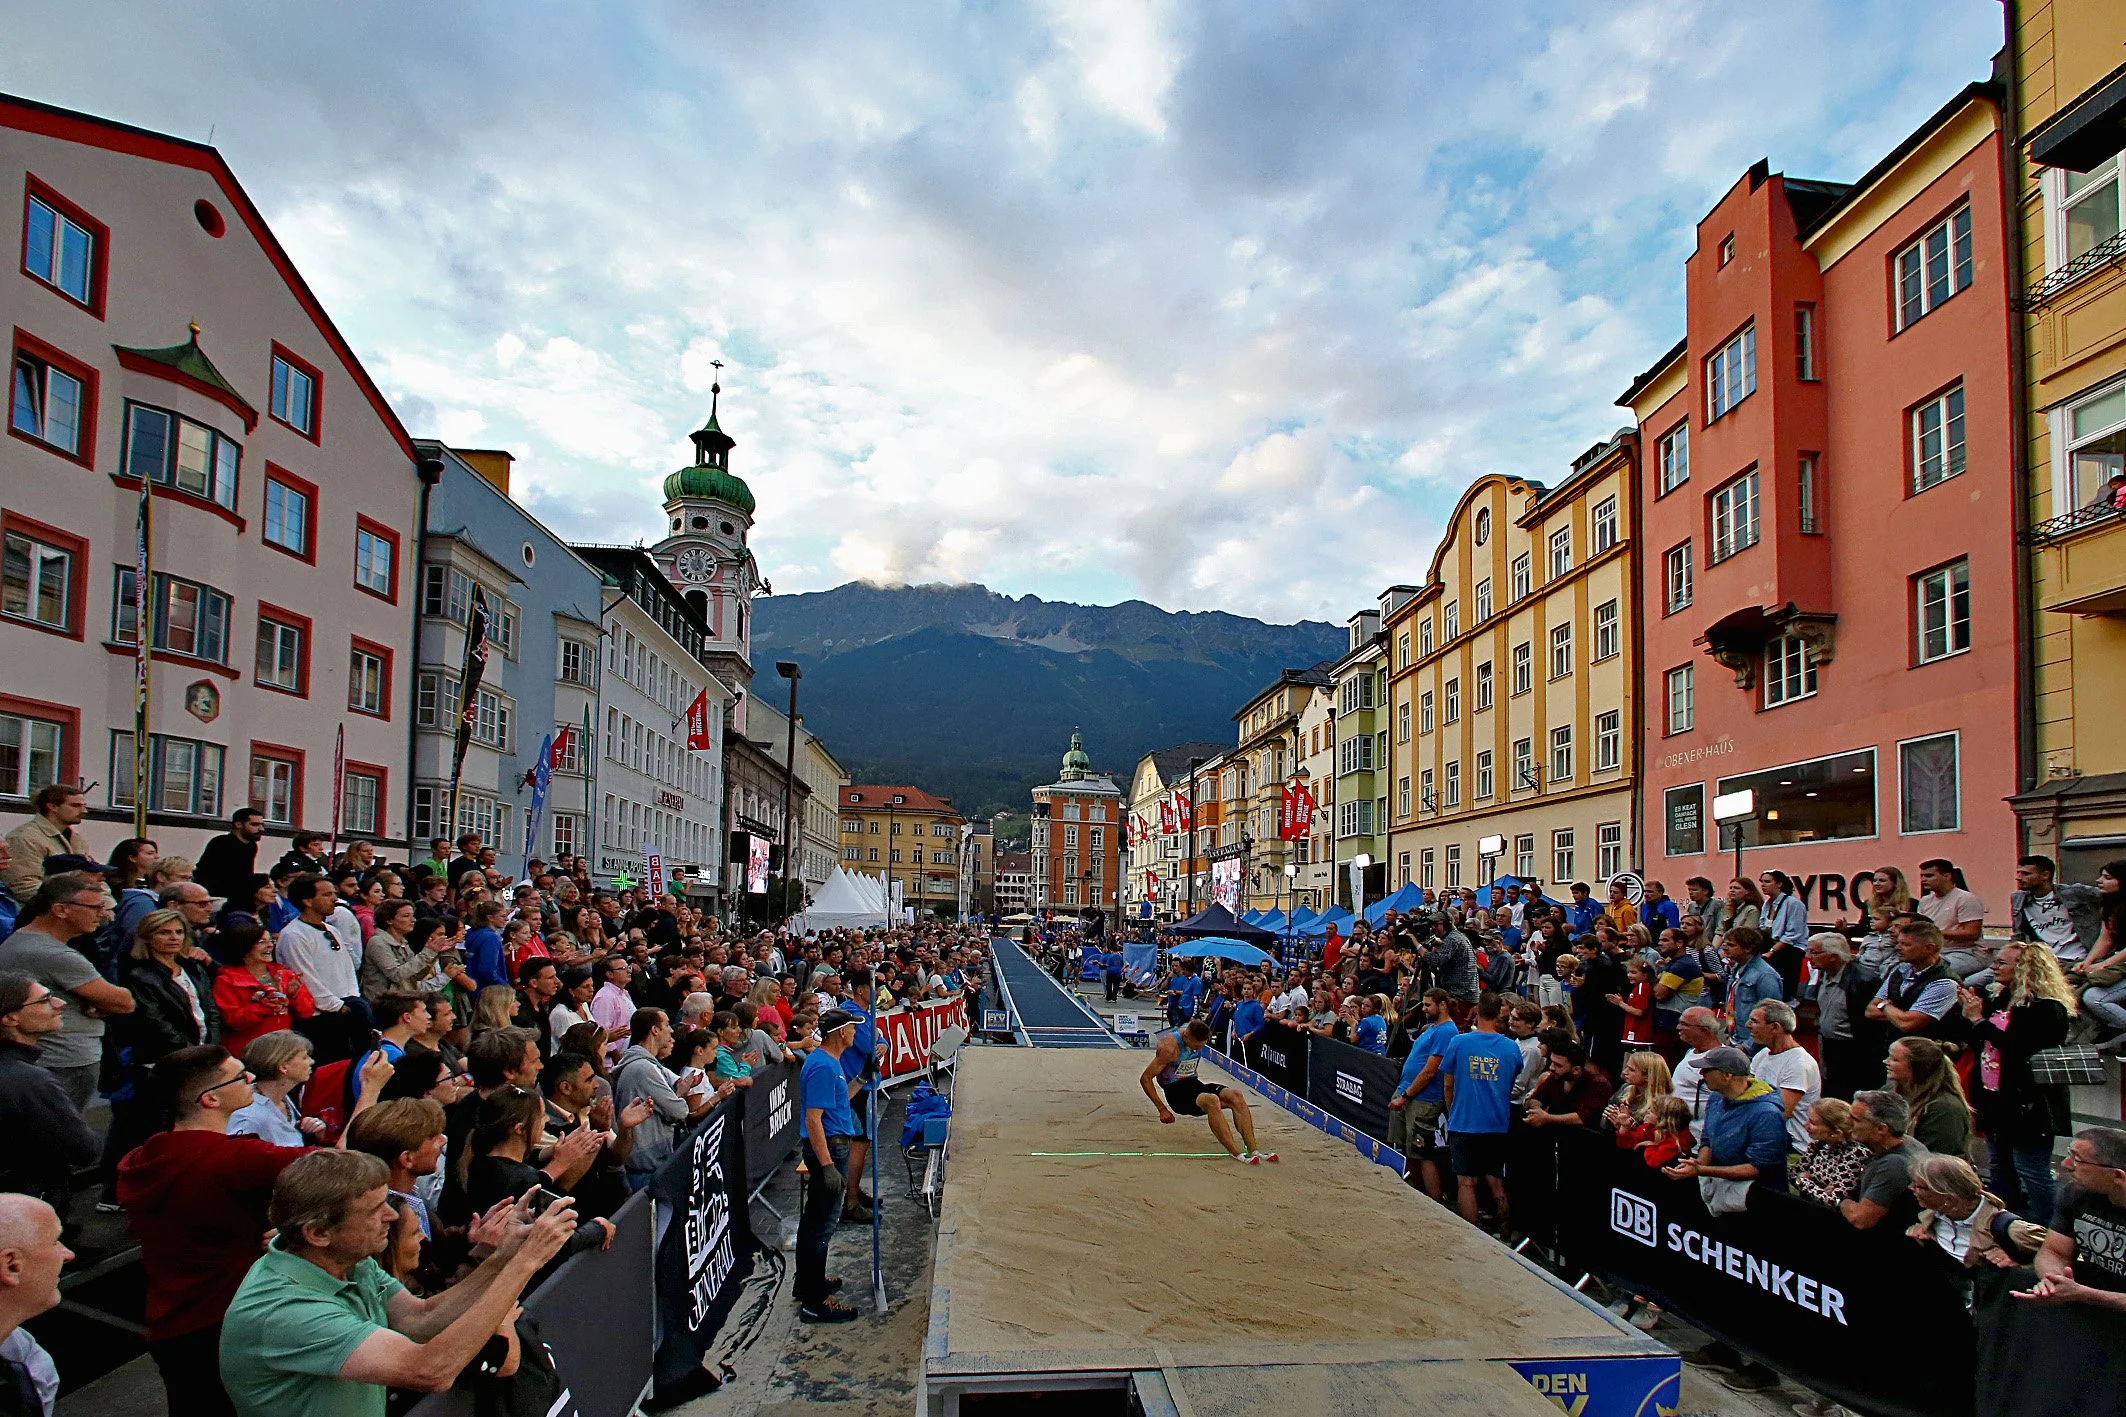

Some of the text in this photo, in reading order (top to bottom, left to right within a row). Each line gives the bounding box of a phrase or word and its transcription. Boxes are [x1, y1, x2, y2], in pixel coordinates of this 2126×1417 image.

[1664, 739, 1734, 768] OBEXER-HAUS
[1674, 803, 1697, 813] ES KEAT
[1675, 821, 1697, 831] GLESN
[1469, 1055, 1500, 1064] GOLDEN
[1469, 1062, 1500, 1075] FLY
[1335, 1076, 1363, 1098] STRABAG
[769, 1099, 792, 1140] BRUCK
[1616, 1195, 1848, 1327] DB SCHENKER
[688, 1229, 736, 1332] GENERALI
